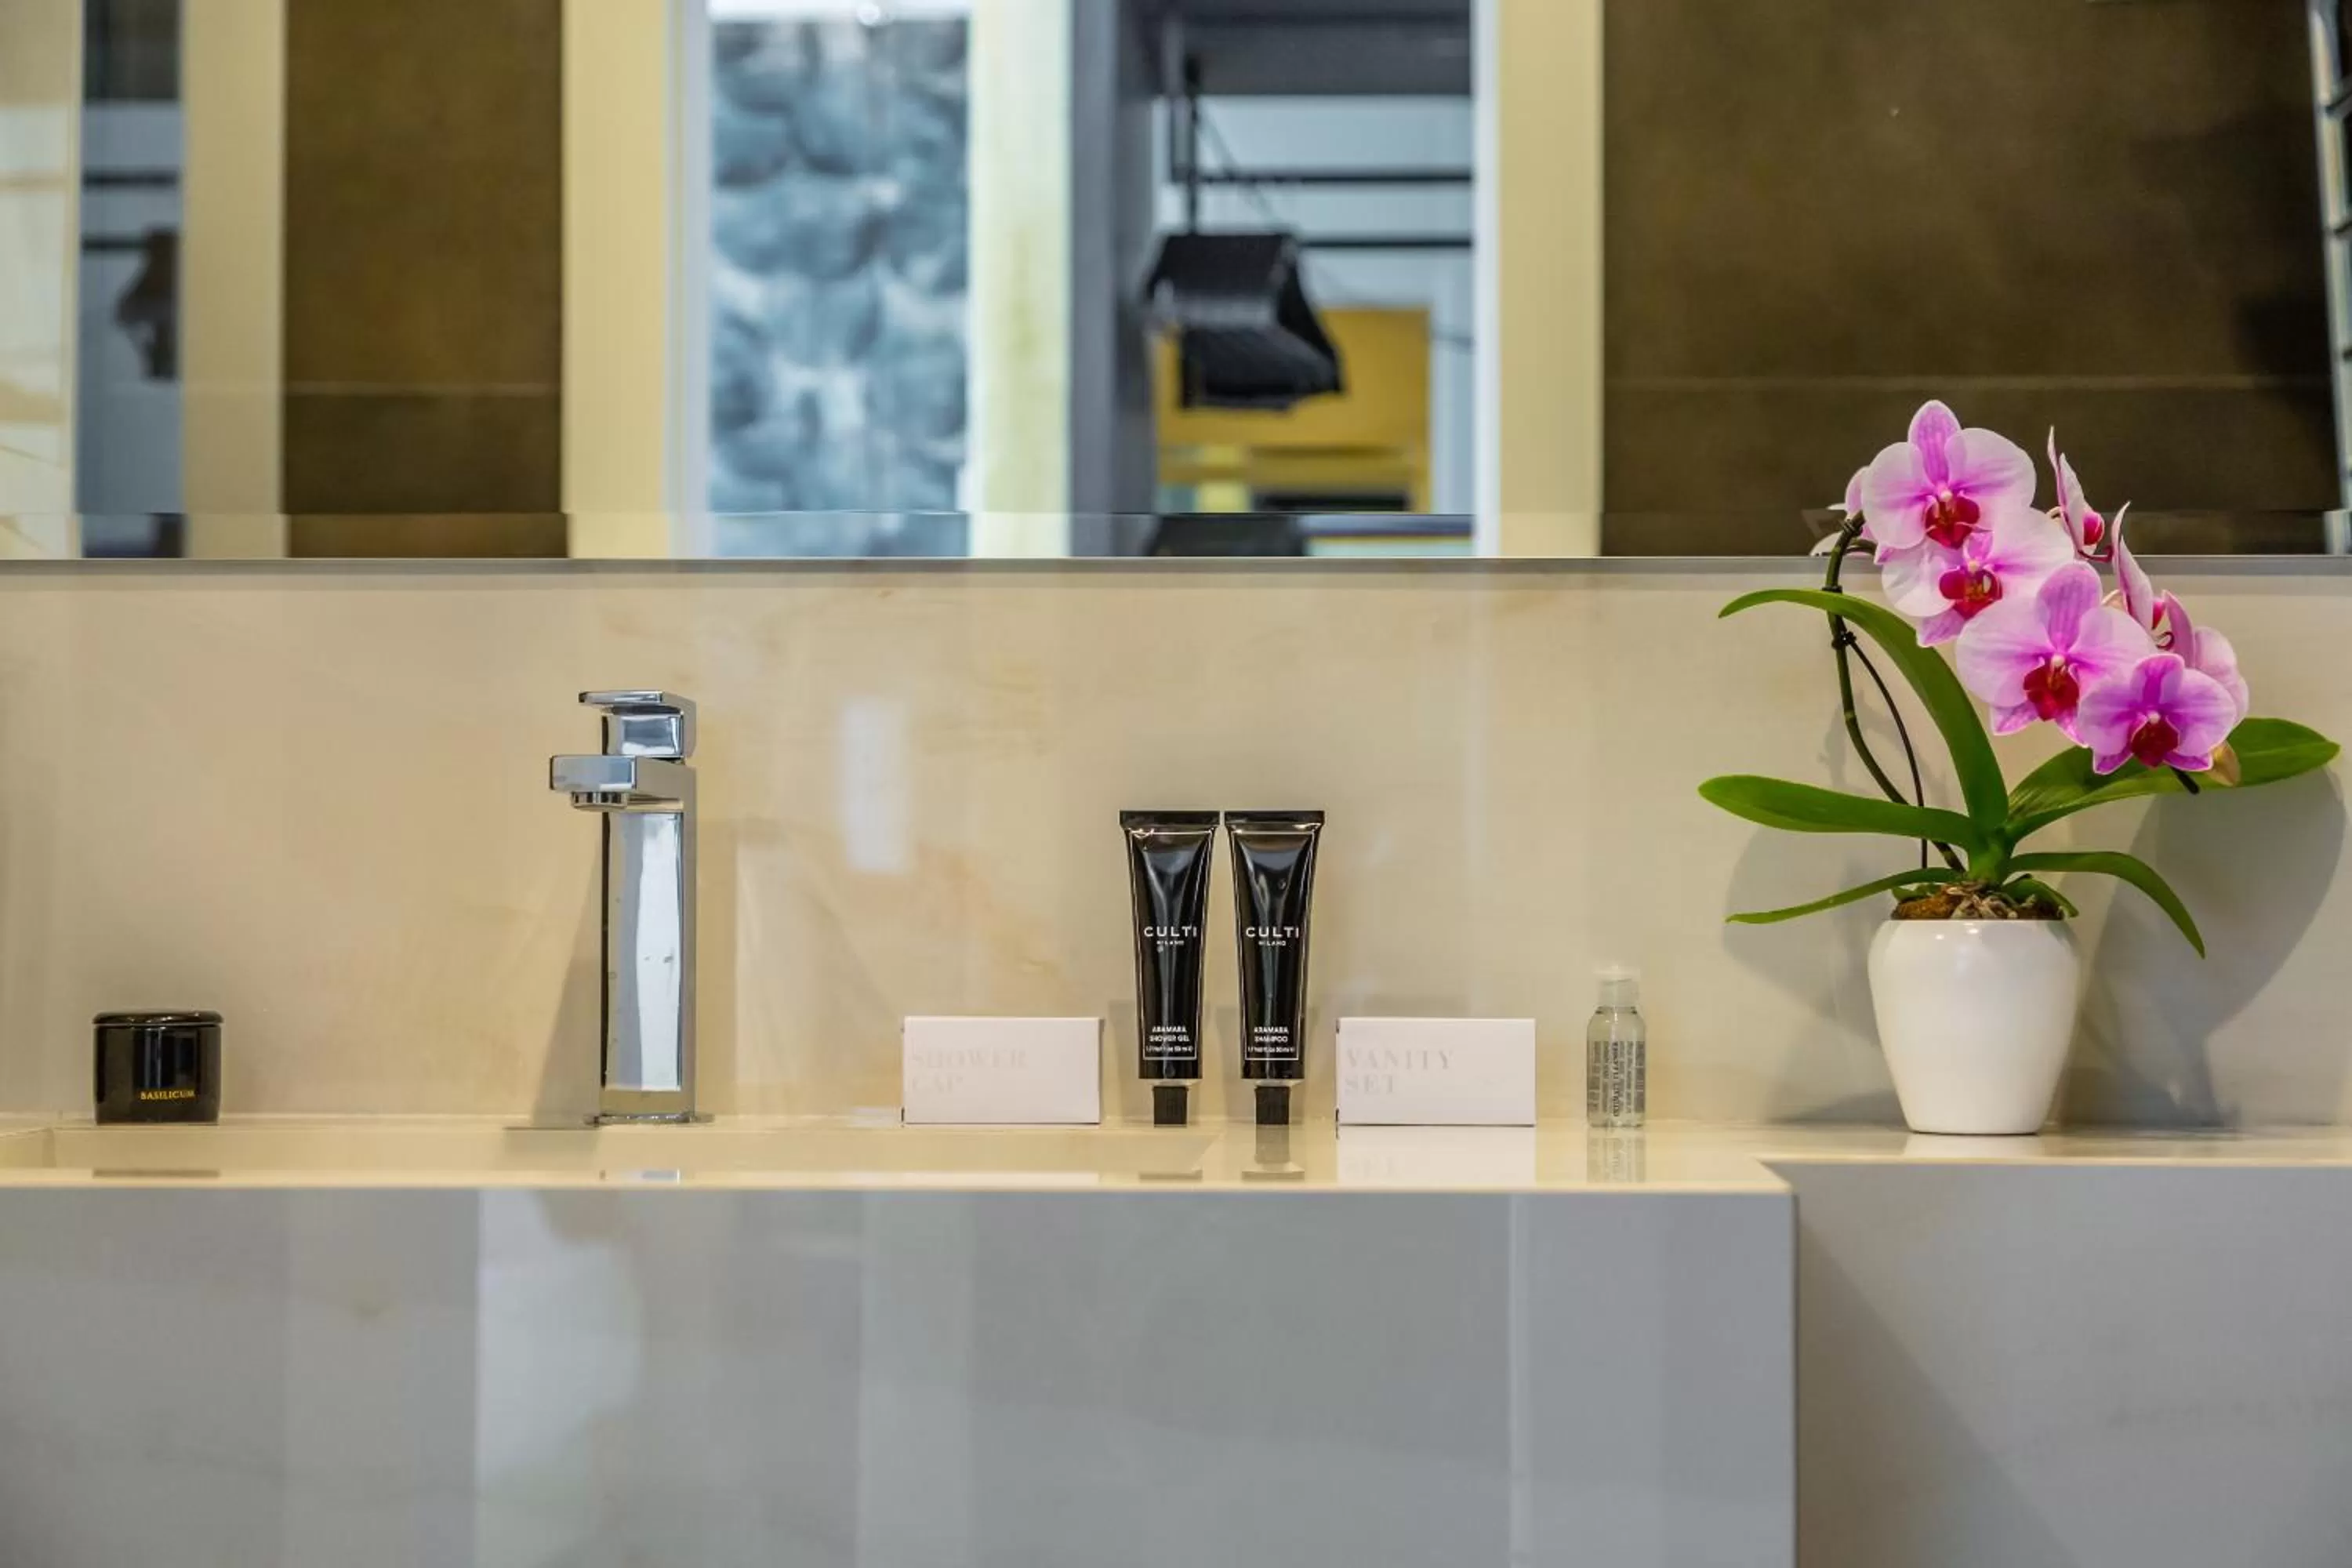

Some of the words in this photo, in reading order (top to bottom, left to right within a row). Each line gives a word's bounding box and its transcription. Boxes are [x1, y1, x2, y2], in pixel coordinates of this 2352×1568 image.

[1144, 926, 1197, 938] CULTI
[1246, 926, 1299, 938] CULTI
[911, 1047, 1027, 1069] SHOWER
[1345, 1048, 1452, 1069] VANITY
[1345, 1075, 1393, 1094] SET
[140, 1089, 195, 1101] BASILICUM
